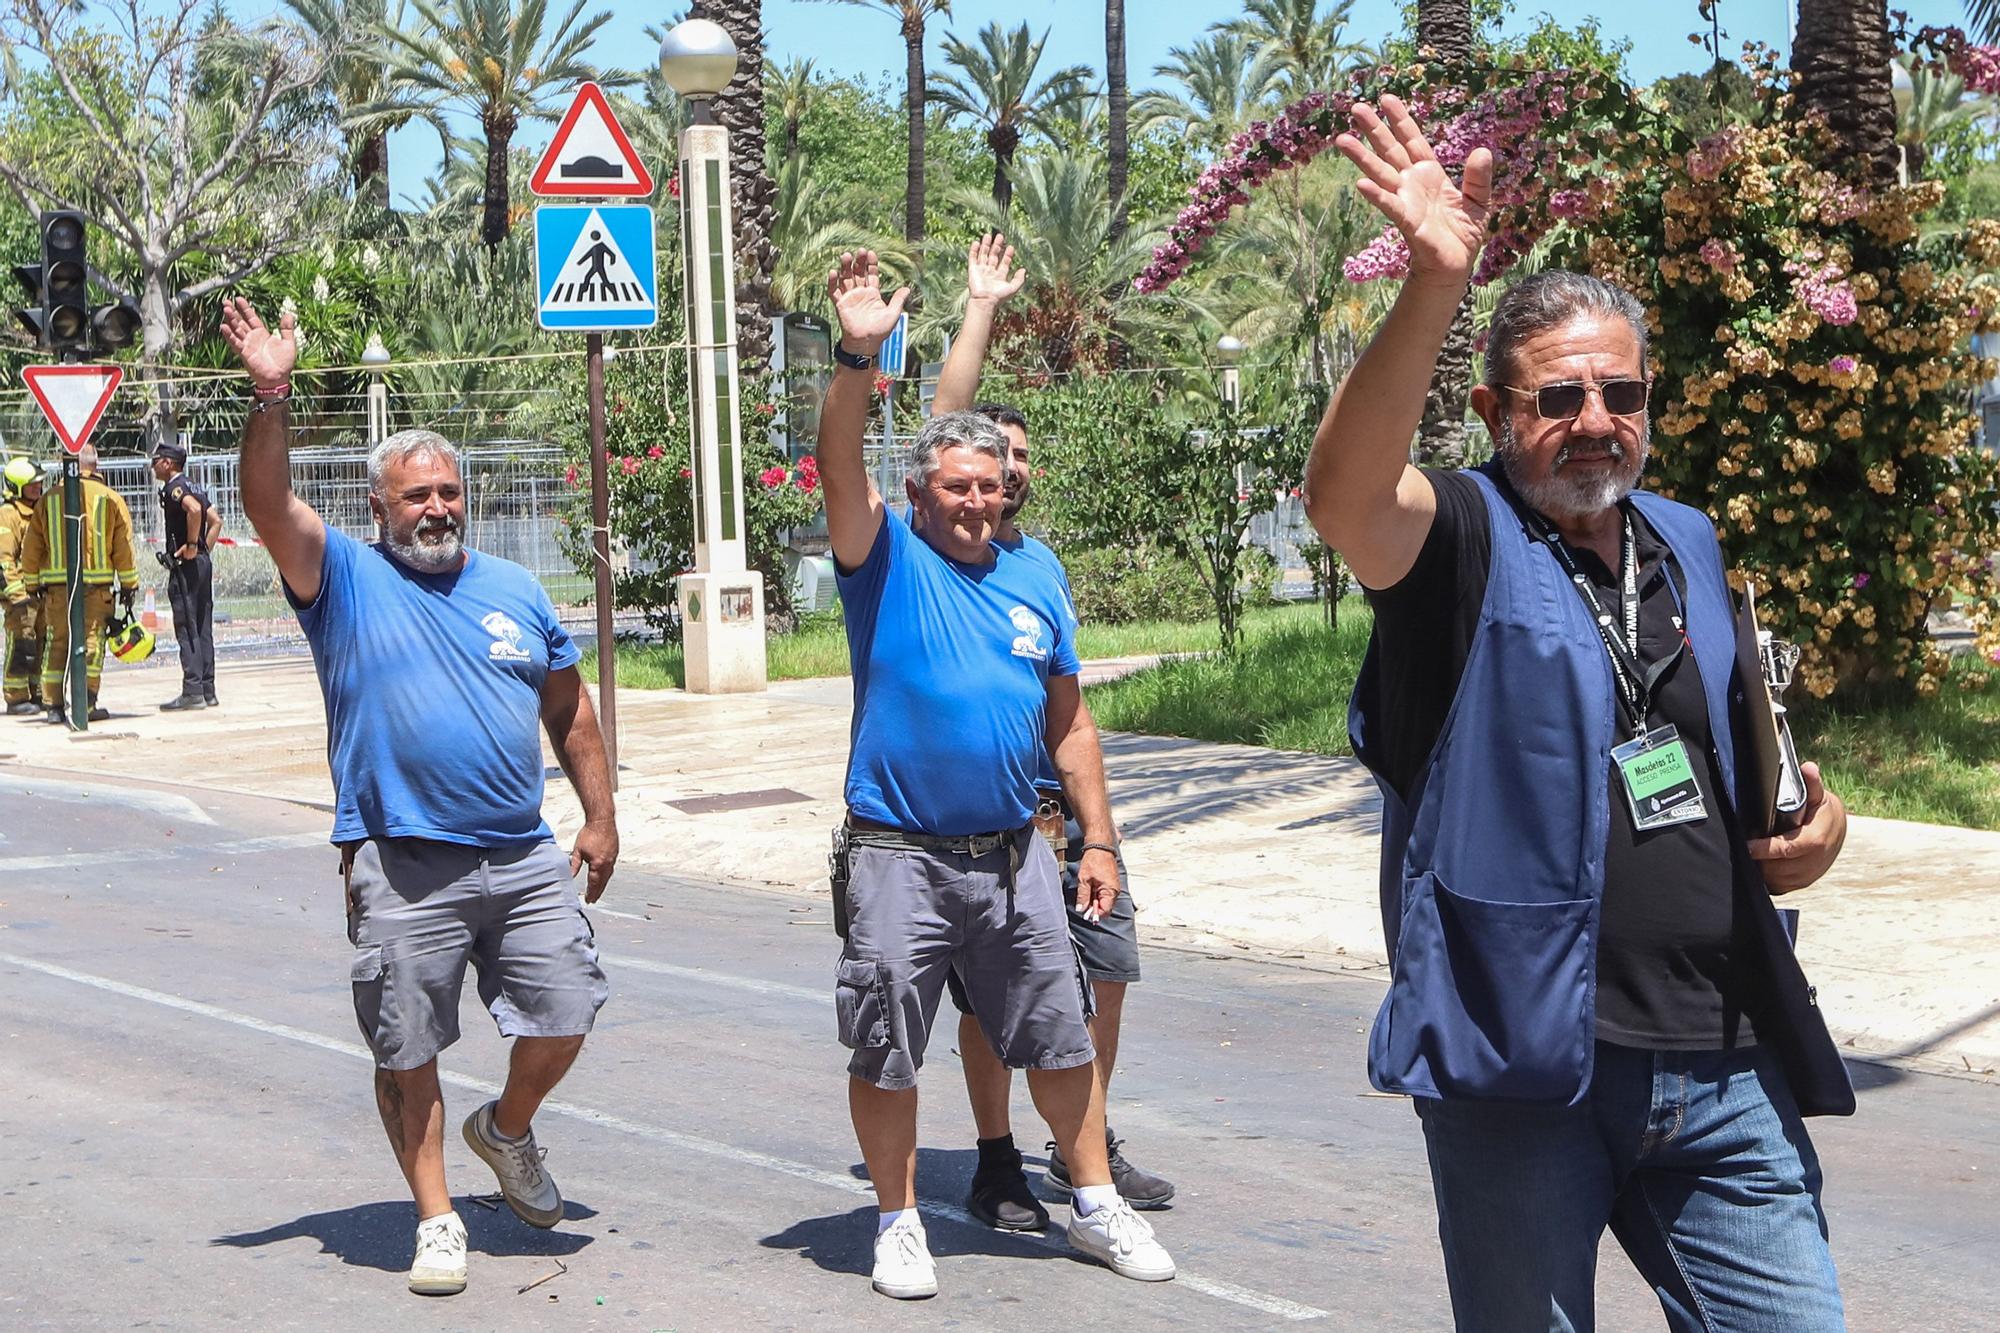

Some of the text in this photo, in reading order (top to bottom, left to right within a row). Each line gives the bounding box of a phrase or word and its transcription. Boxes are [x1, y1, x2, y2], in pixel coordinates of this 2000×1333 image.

[68, 462, 79, 477] 8
[1665, 752, 1676, 764] 22
[1636, 763, 1682, 785] ACCESO PRENSA
